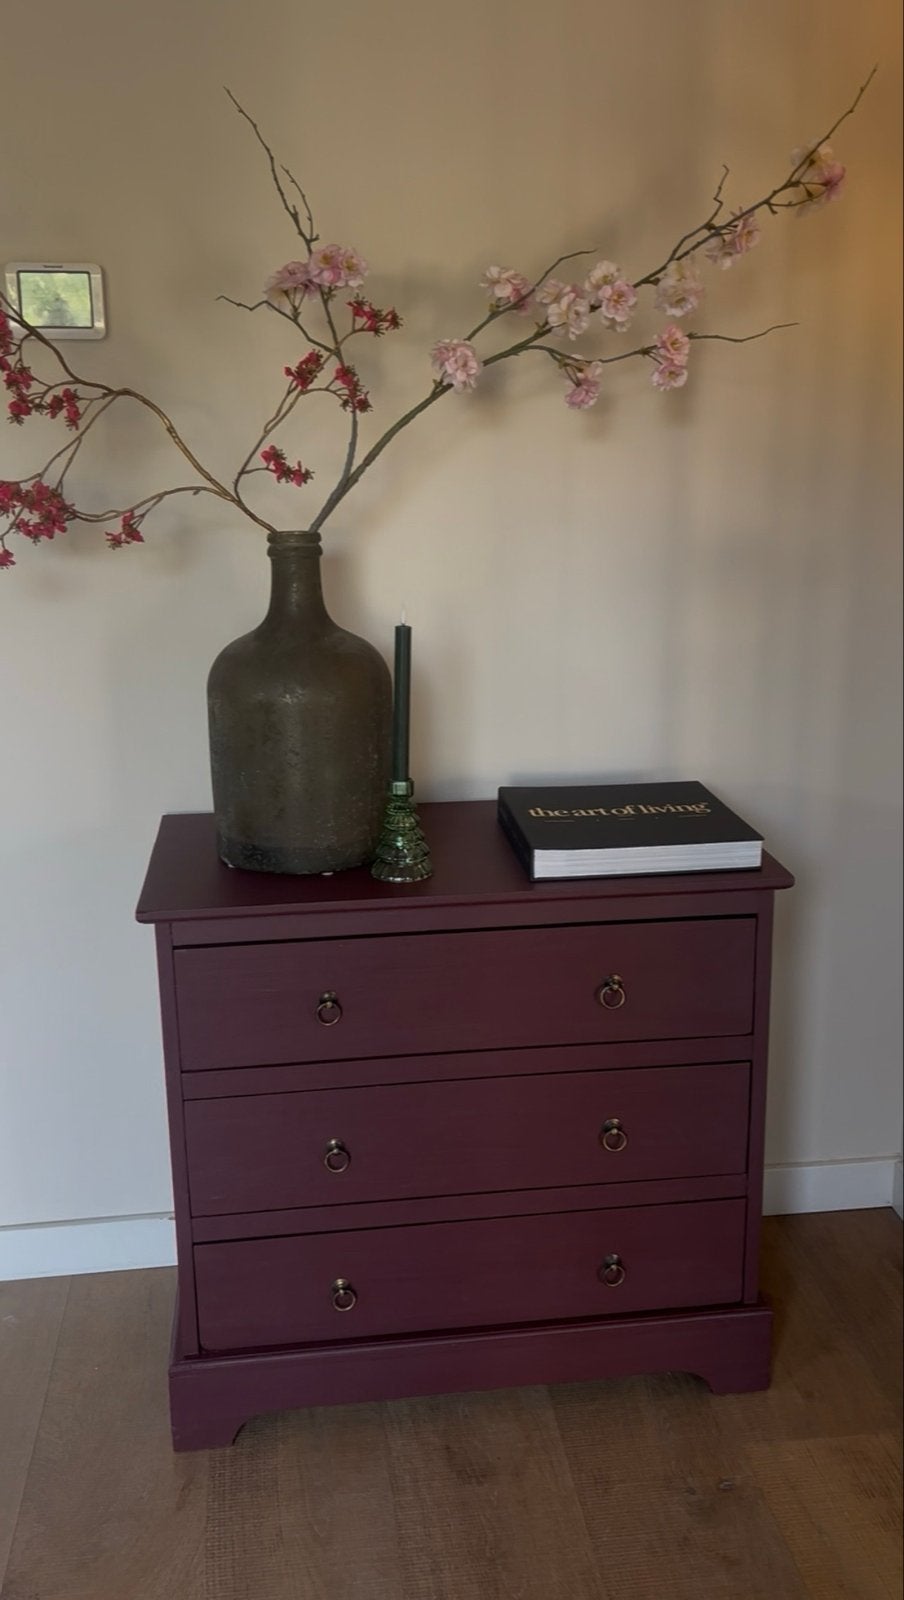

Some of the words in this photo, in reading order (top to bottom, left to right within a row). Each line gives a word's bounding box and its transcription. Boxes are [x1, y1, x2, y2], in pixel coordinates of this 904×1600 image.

[528, 807, 568, 818] the
[571, 805, 608, 817] art
[611, 804, 636, 816] of
[639, 803, 711, 815] living
